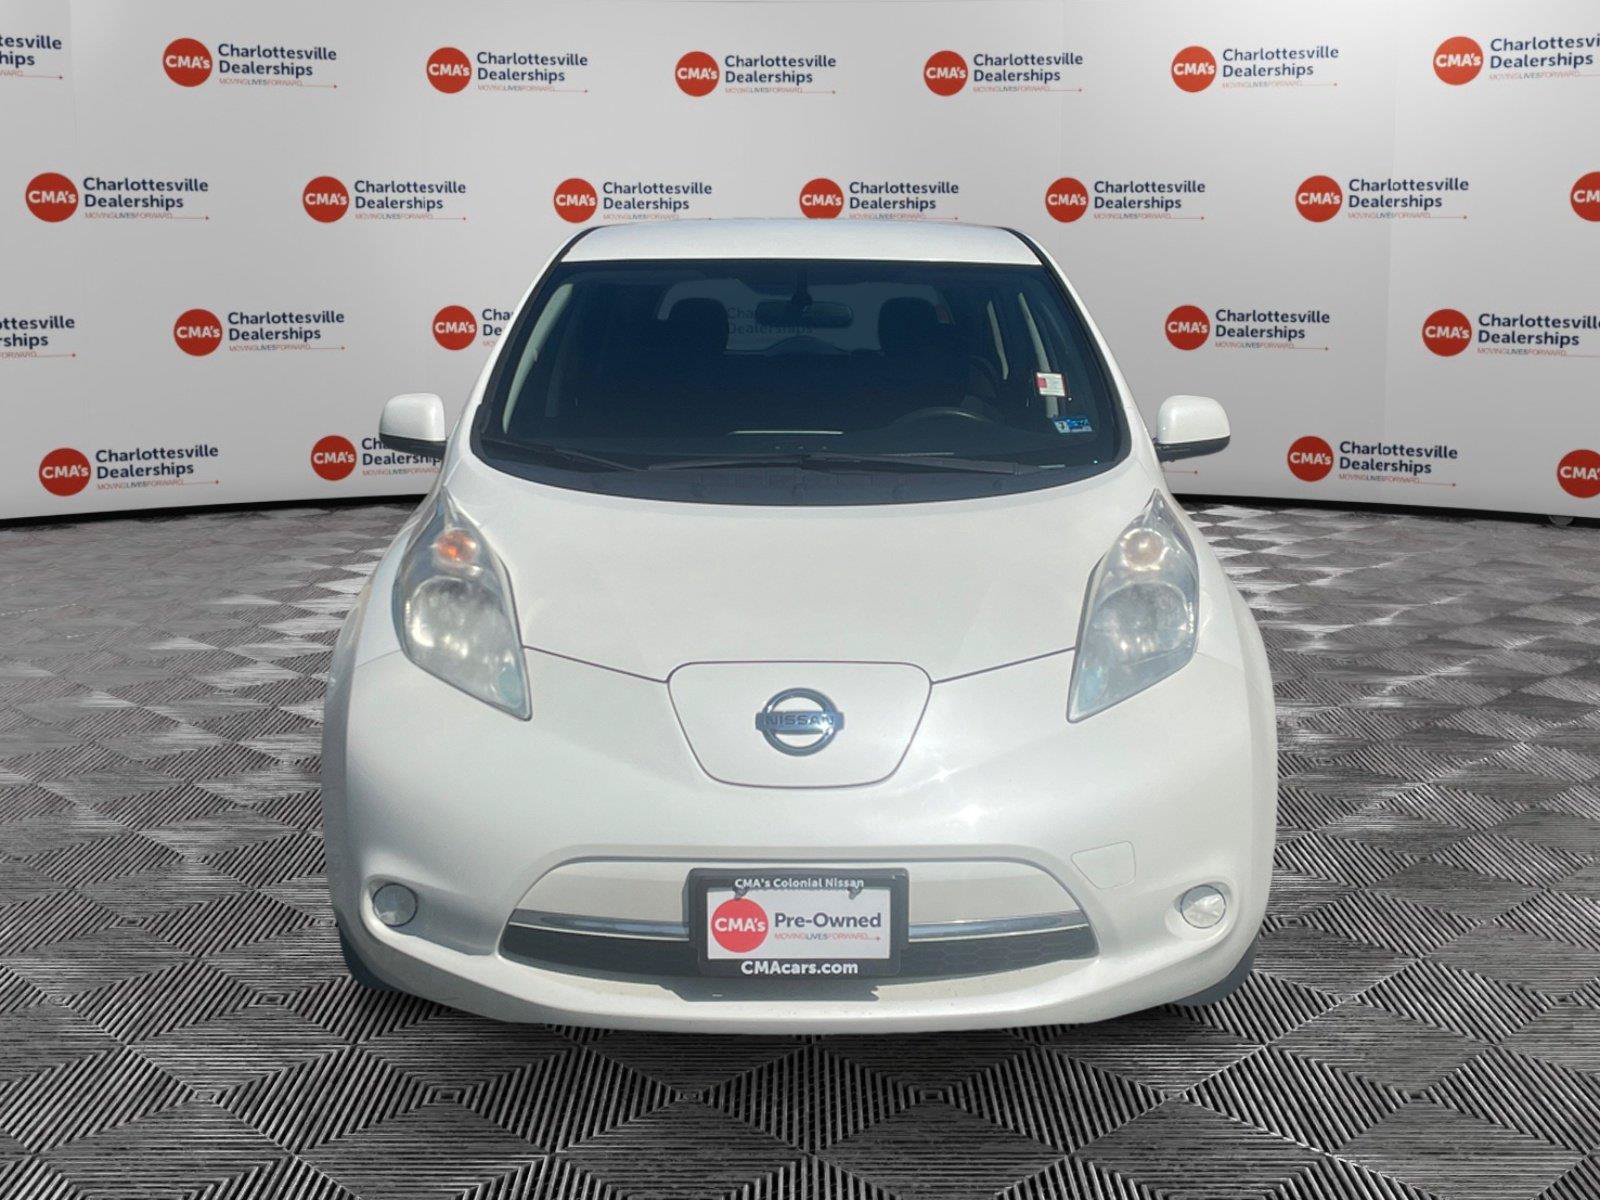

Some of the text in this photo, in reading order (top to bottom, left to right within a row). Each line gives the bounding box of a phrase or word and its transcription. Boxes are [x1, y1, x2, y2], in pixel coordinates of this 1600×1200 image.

[218, 43, 336, 60] Charlottesville
[477, 52, 587, 66] Charlottesville
[1223, 46, 1339, 61] Charlottesville
[165, 54, 210, 70] CMA's
[725, 55, 836, 67] Charlottesville
[973, 53, 1083, 66] Charlottesville
[1435, 53, 1482, 69] CMA's
[1490, 53, 1593, 69] Dealerships
[219, 60, 313, 79] Dealerships
[429, 62, 470, 77] CMA's
[478, 67, 565, 84] Dealerships
[678, 66, 718, 81] CMA's
[926, 66, 966, 80] CMA's
[1173, 60, 1215, 77] CMA's
[1223, 63, 1313, 79] Dealerships
[726, 70, 813, 86] Dealerships
[974, 69, 1060, 84] Dealerships
[83, 177, 208, 192] Charlottesville
[354, 180, 466, 193] Charlottesville
[602, 181, 712, 194] Charlottesville
[849, 181, 959, 194] Charlottesville
[1094, 180, 1205, 193] Charlottesville
[1349, 178, 1468, 192] Charlottesville
[27, 191, 76, 206] CMA's
[84, 194, 184, 211] Dealerships
[305, 192, 347, 206] CMA's
[355, 196, 443, 212] Dealerships
[556, 193, 596, 207] CMA's
[603, 197, 689, 213] Dealerships
[802, 193, 842, 207] CMA's
[850, 197, 936, 212] Dealerships
[1048, 193, 1086, 206] CMA's
[1094, 196, 1181, 212] Dealerships
[1298, 191, 1341, 205] CMA's
[1349, 195, 1442, 211] Dealerships
[228, 311, 344, 325] Charlottesville
[1215, 308, 1330, 323] Charlottesville
[177, 325, 220, 339] CMA's
[229, 327, 321, 342] Dealerships
[435, 321, 475, 334] CMA's
[1168, 321, 1207, 334] CMA's
[1216, 324, 1305, 342] Dealerships
[1425, 325, 1469, 339] CMA's
[1478, 329, 1579, 348] Dealerships
[96, 444, 218, 463] Charlottesville
[1339, 441, 1457, 459] Charlottesville
[313, 451, 355, 465] CMA's
[1290, 451, 1331, 465] CMA's
[42, 464, 88, 479] CMA's
[97, 463, 194, 479] Dealerships
[1340, 456, 1431, 476] Dealerships
[764, 714, 833, 726] NISSAN
[734, 877, 864, 889] CMA's Colonial Nissan
[714, 917, 767, 933] CMA's
[774, 912, 882, 928] Pre-Owned
[740, 960, 859, 975] CMAcars.com
